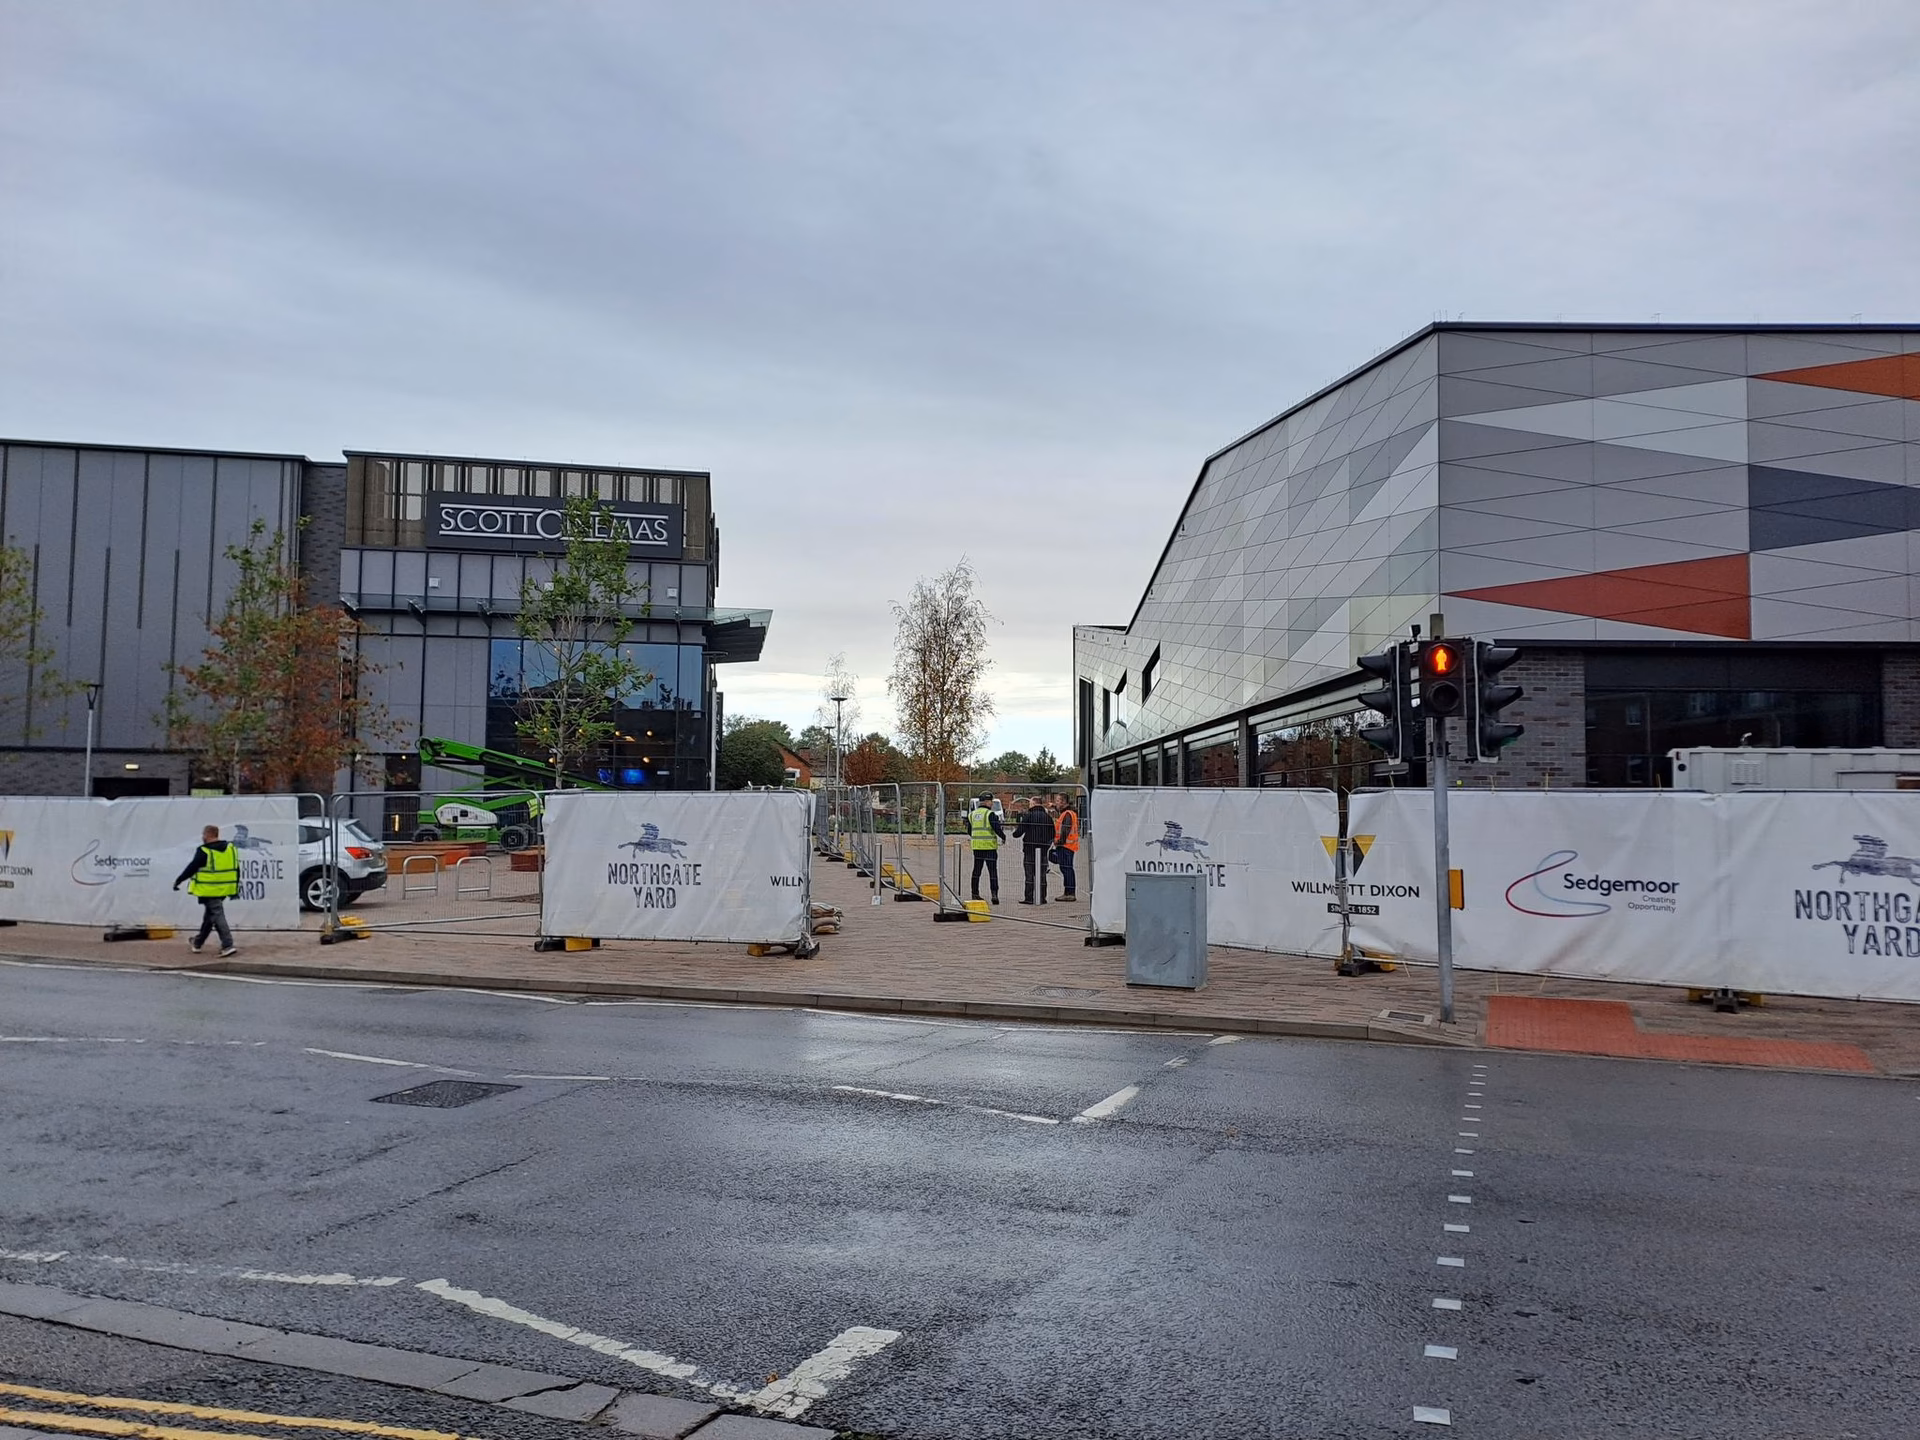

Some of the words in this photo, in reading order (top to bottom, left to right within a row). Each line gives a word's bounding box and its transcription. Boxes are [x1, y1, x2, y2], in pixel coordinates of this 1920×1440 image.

[239, 860, 284, 880] HGATE
[608, 863, 702, 886] NORTHGATE
[238, 881, 265, 901] ARD
[1370, 885, 1420, 898] DIXON
[1563, 873, 1680, 896] Sedgemoor
[633, 887, 677, 909] YARD
[1627, 901, 1676, 914] Opportunity
[1642, 895, 1676, 905] Creating
[1357, 905, 1376, 914] 1852
[1842, 924, 1920, 958] YARD
